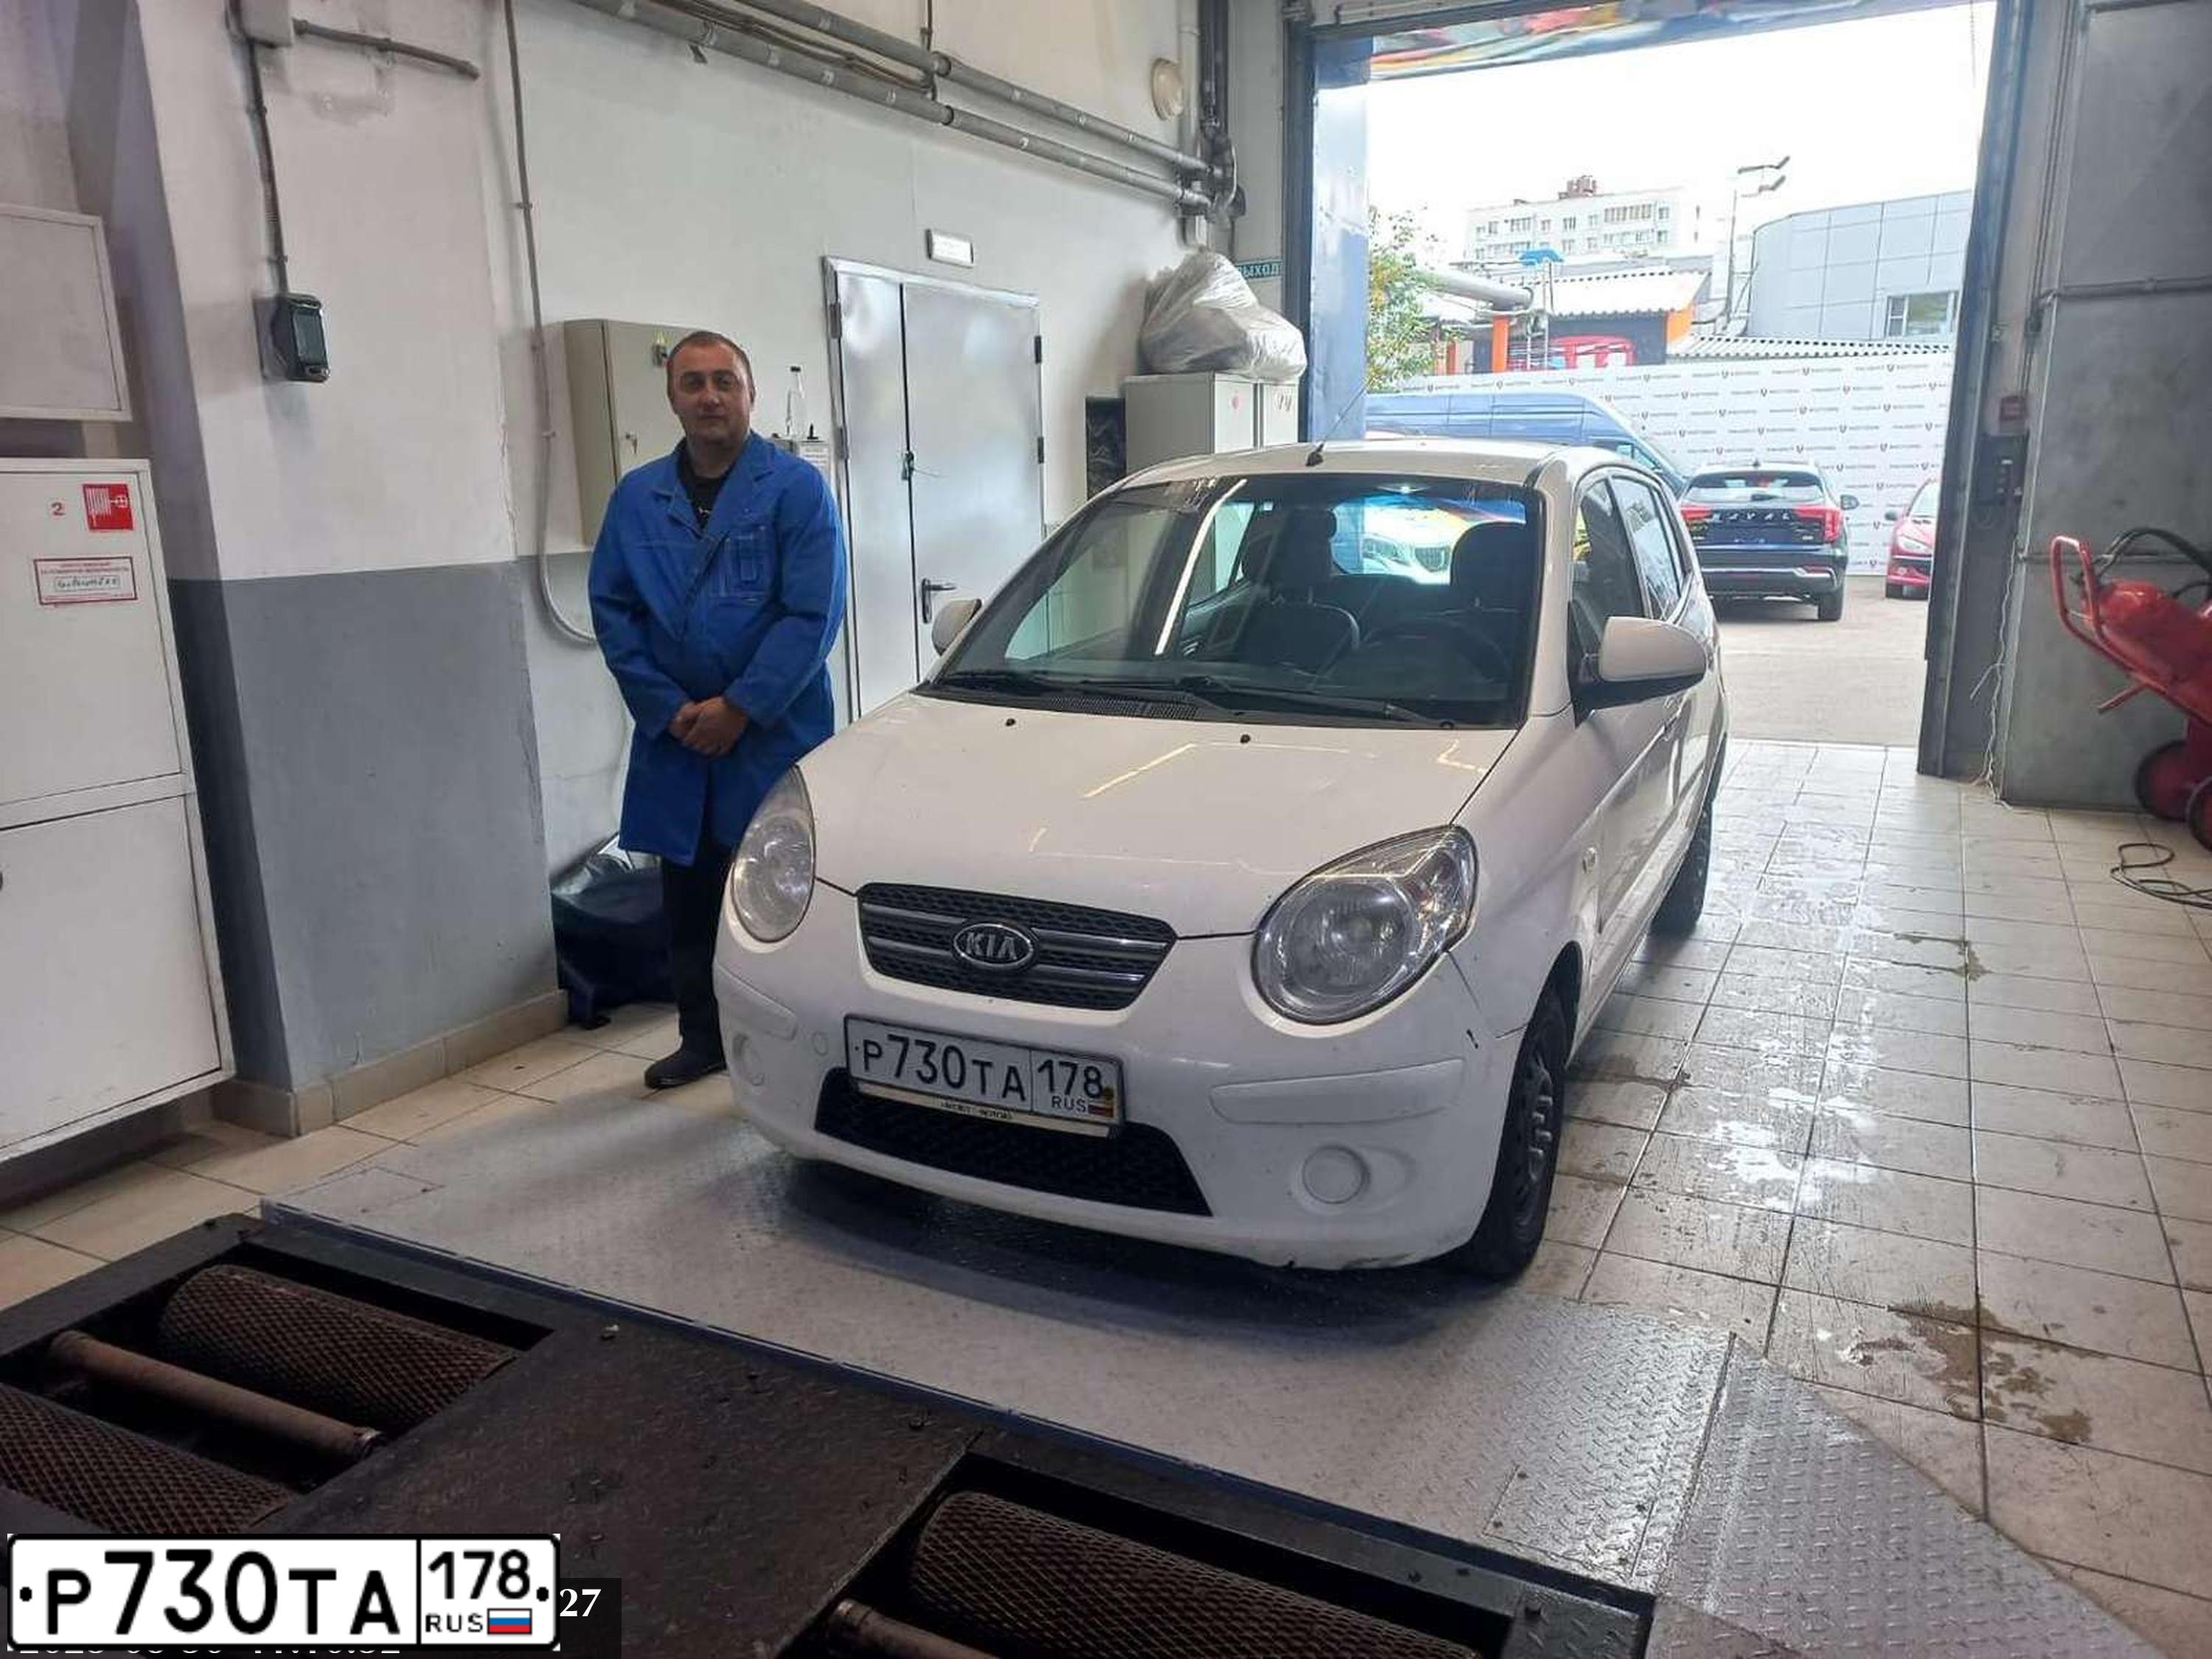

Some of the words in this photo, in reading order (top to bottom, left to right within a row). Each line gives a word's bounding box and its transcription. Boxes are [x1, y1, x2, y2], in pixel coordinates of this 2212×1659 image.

[51, 501, 66, 516] 2
[966, 932, 1018, 960] KIA
[1037, 1060, 1103, 1099] 178
[1051, 1096, 1086, 1113] RUS
